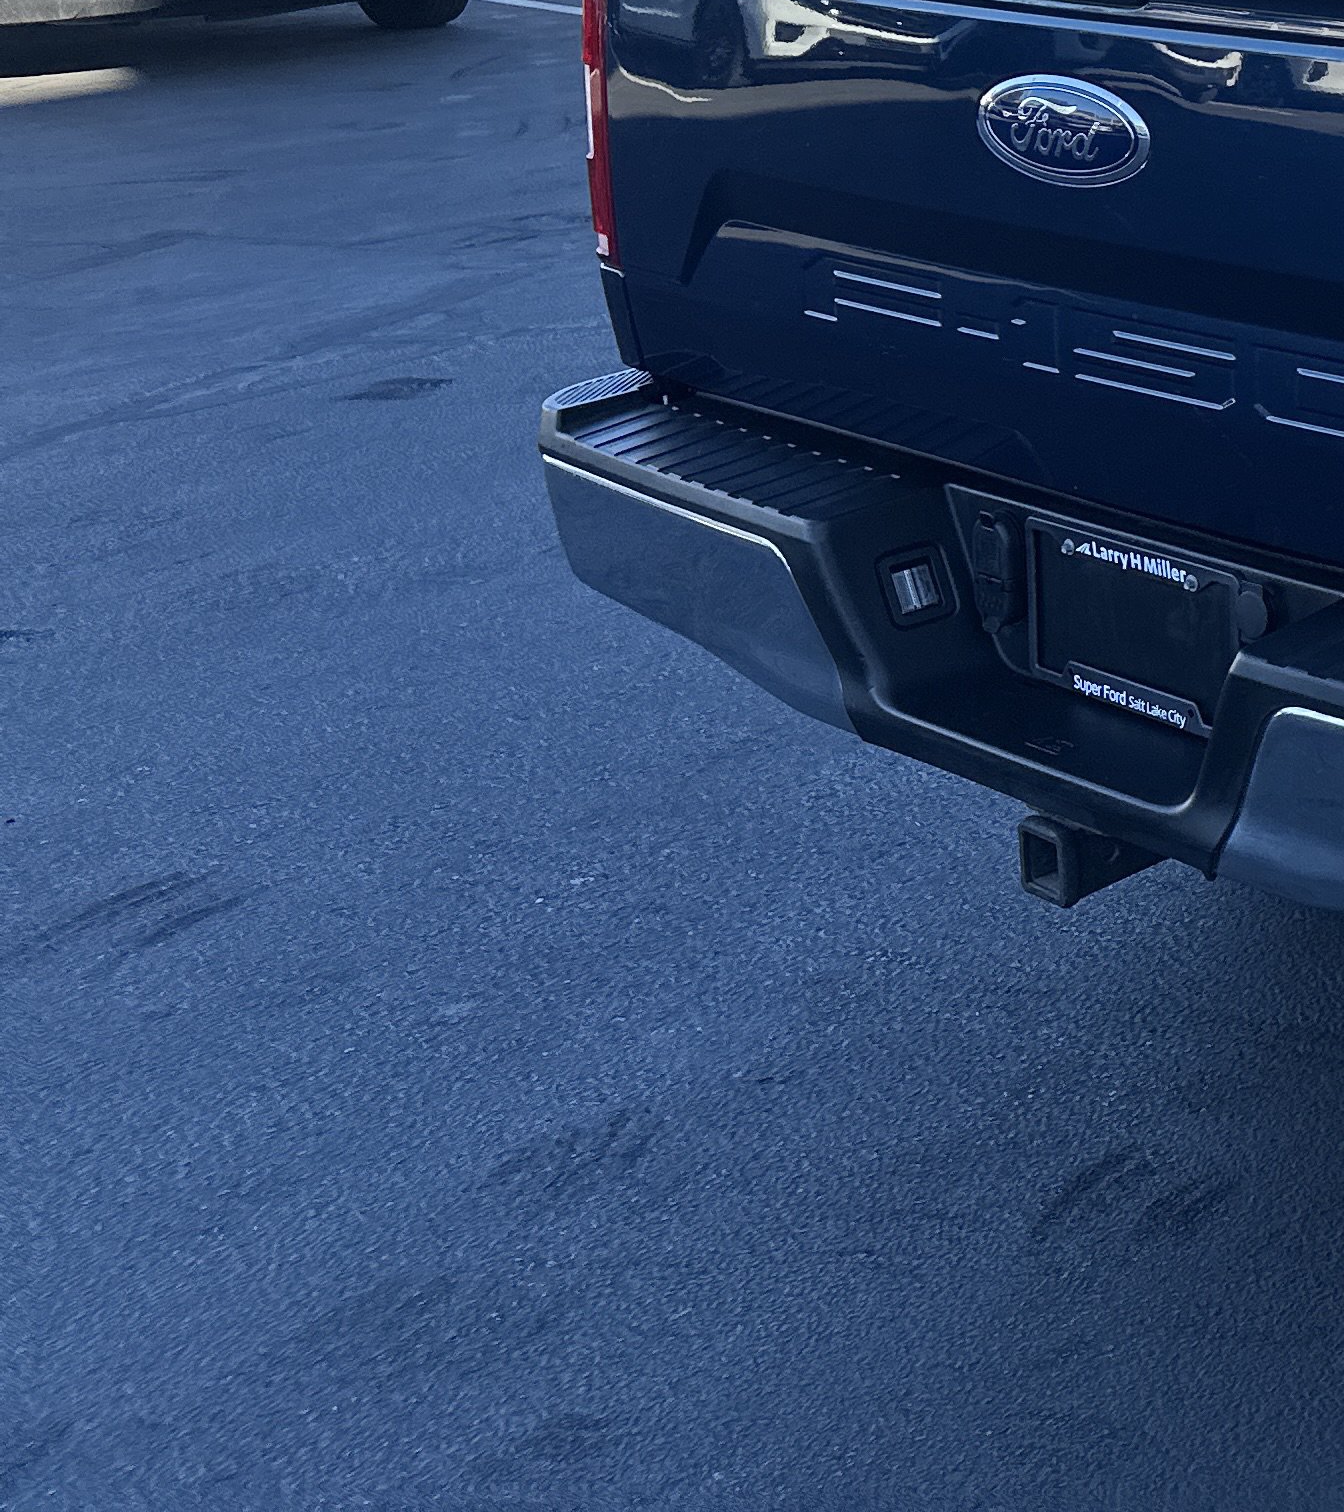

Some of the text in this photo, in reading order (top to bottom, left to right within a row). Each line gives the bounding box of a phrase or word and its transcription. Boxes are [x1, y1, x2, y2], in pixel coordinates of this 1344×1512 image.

[1002, 95, 1100, 162] Ford
[1091, 540, 1187, 583] Larry H Miller
[1073, 674, 1103, 697] Super
[1103, 684, 1127, 706] Ford
[1146, 701, 1168, 720] Lake
[1167, 709, 1187, 729] City
